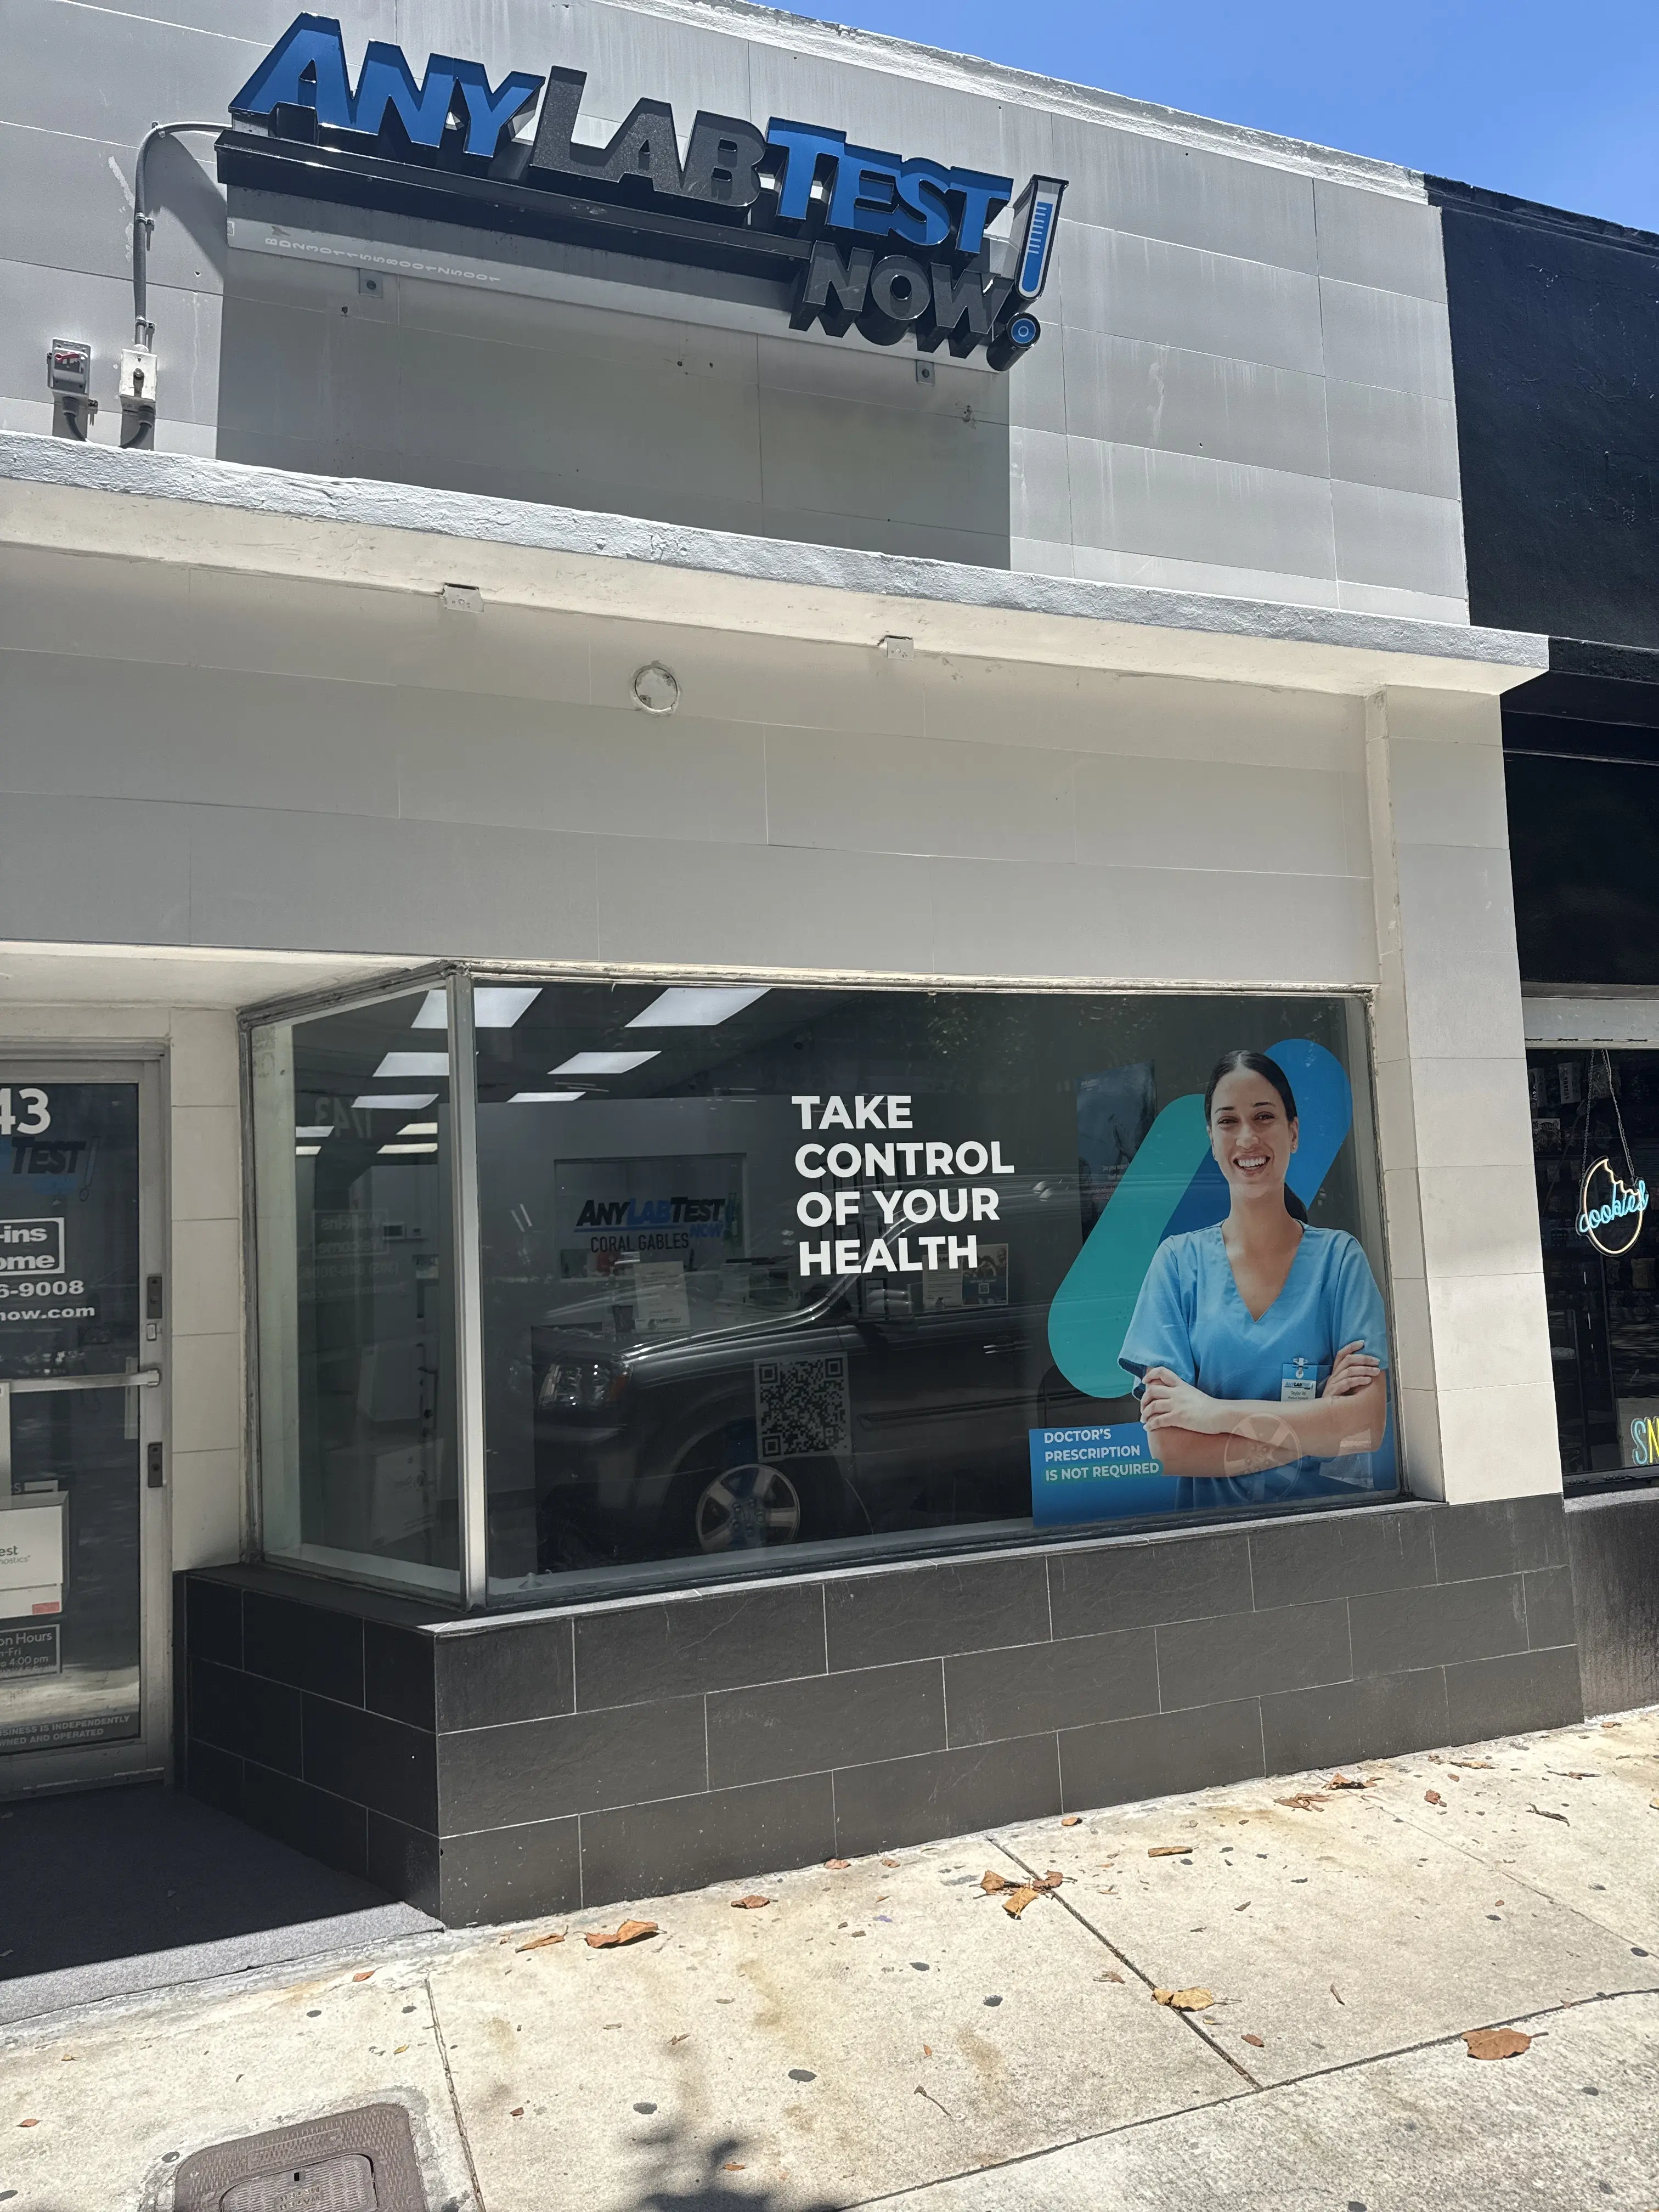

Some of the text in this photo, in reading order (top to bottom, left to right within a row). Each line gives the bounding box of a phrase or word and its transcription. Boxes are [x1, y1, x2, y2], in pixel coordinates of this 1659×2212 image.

[792, 1095, 913, 1130] TAKE
[12, 1136, 87, 1174] TEST
[794, 1141, 1015, 1179] CONTROL
[797, 1188, 1001, 1228] OF YOUR
[1579, 1180, 1649, 1233] cookies
[590, 1233, 690, 1253] CORAL GABLES
[799, 1235, 978, 1277] HEALTH
[0, 1280, 84, 1299] 6-9008
[1044, 1428, 1111, 1443] DOCTOR'S
[1045, 1444, 1140, 1463] PRESCRIPTION
[1046, 1462, 1159, 1481] IS NOT REQUIRED
[0, 1545, 19, 1556] est
[15, 1632, 53, 1645] Hours
[33, 1657, 48, 1665] pm
[40, 1724, 49, 1733] IS
[52, 1715, 130, 1730] INDEPENDENTLY
[29, 1734, 50, 1744] AND
[53, 1728, 104, 1741] OPERATED
[280, 2186, 320, 2202] METER
[280, 2196, 320, 2210] WATER
